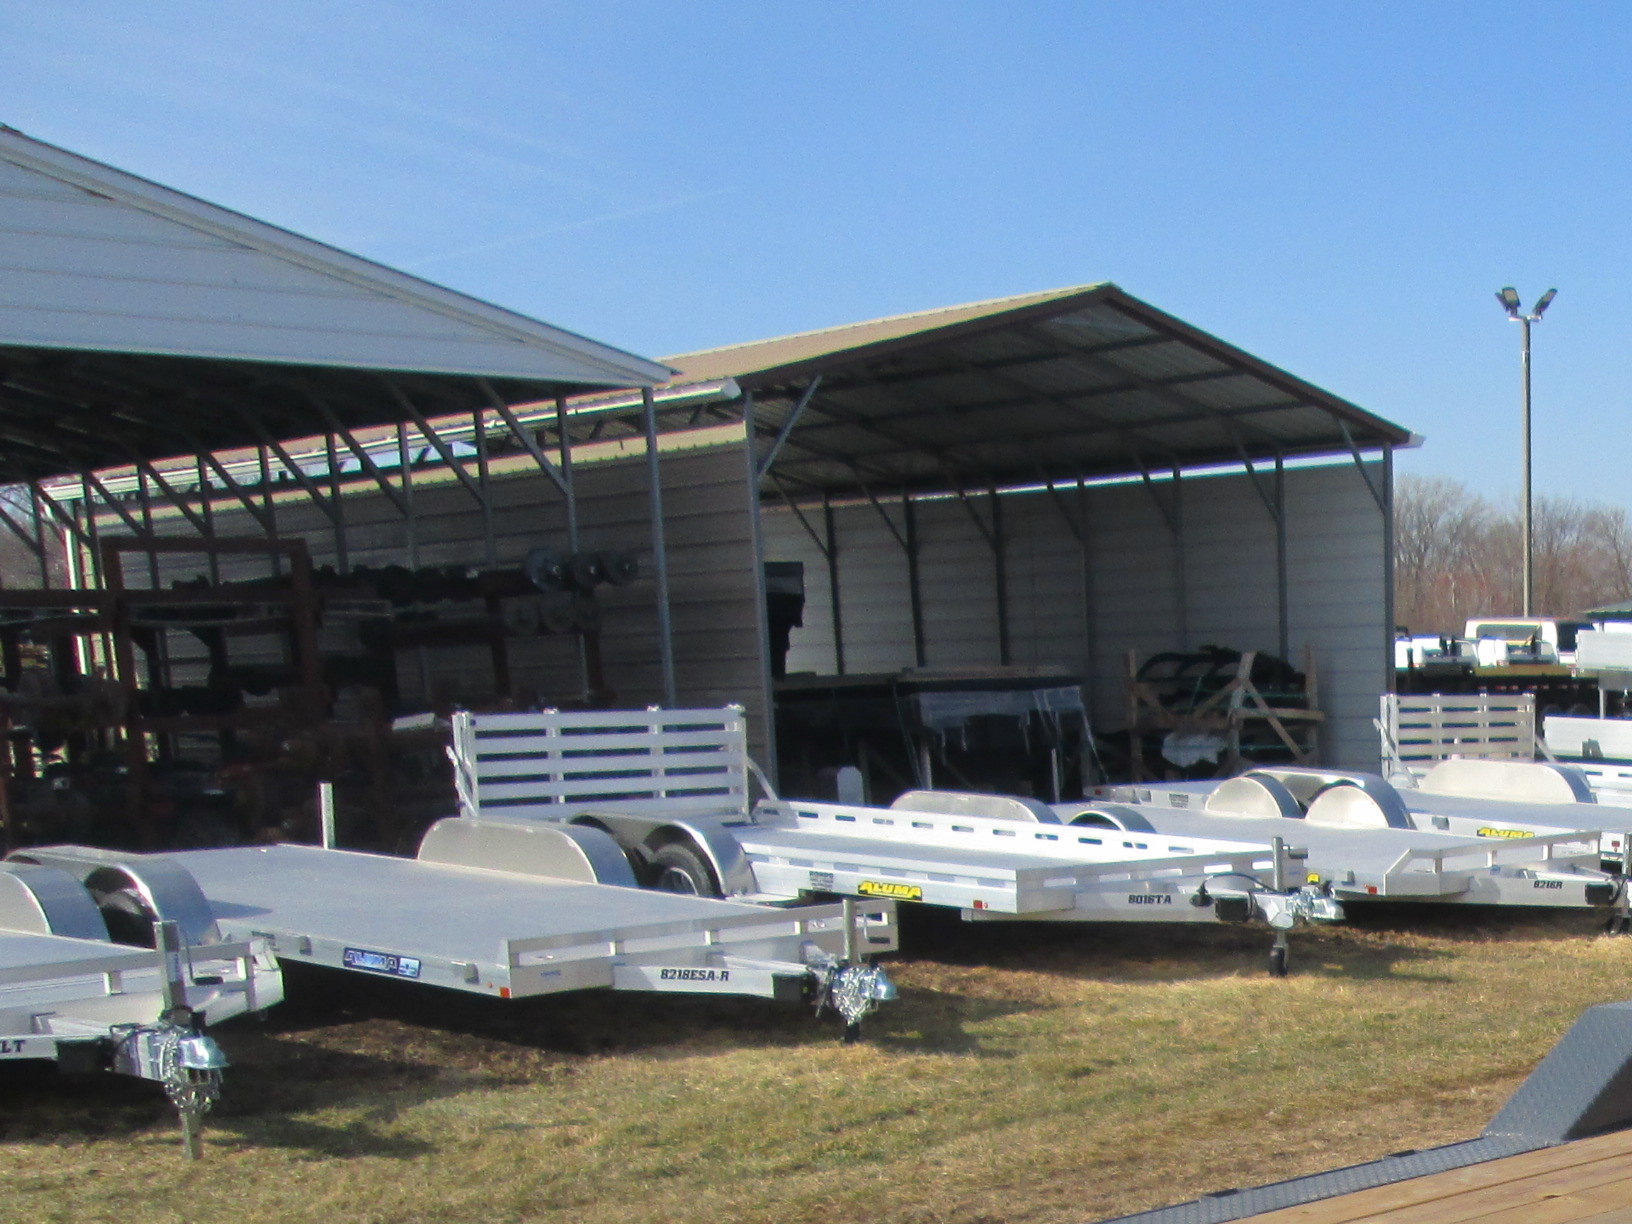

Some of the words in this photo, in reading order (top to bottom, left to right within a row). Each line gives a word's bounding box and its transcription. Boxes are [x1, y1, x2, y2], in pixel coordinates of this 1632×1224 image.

[1478, 827, 1535, 838] ALUMA
[858, 881, 922, 900] ALUMA
[344, 950, 398, 971] ALUMA
[660, 968, 730, 982] 8218ESA-R
